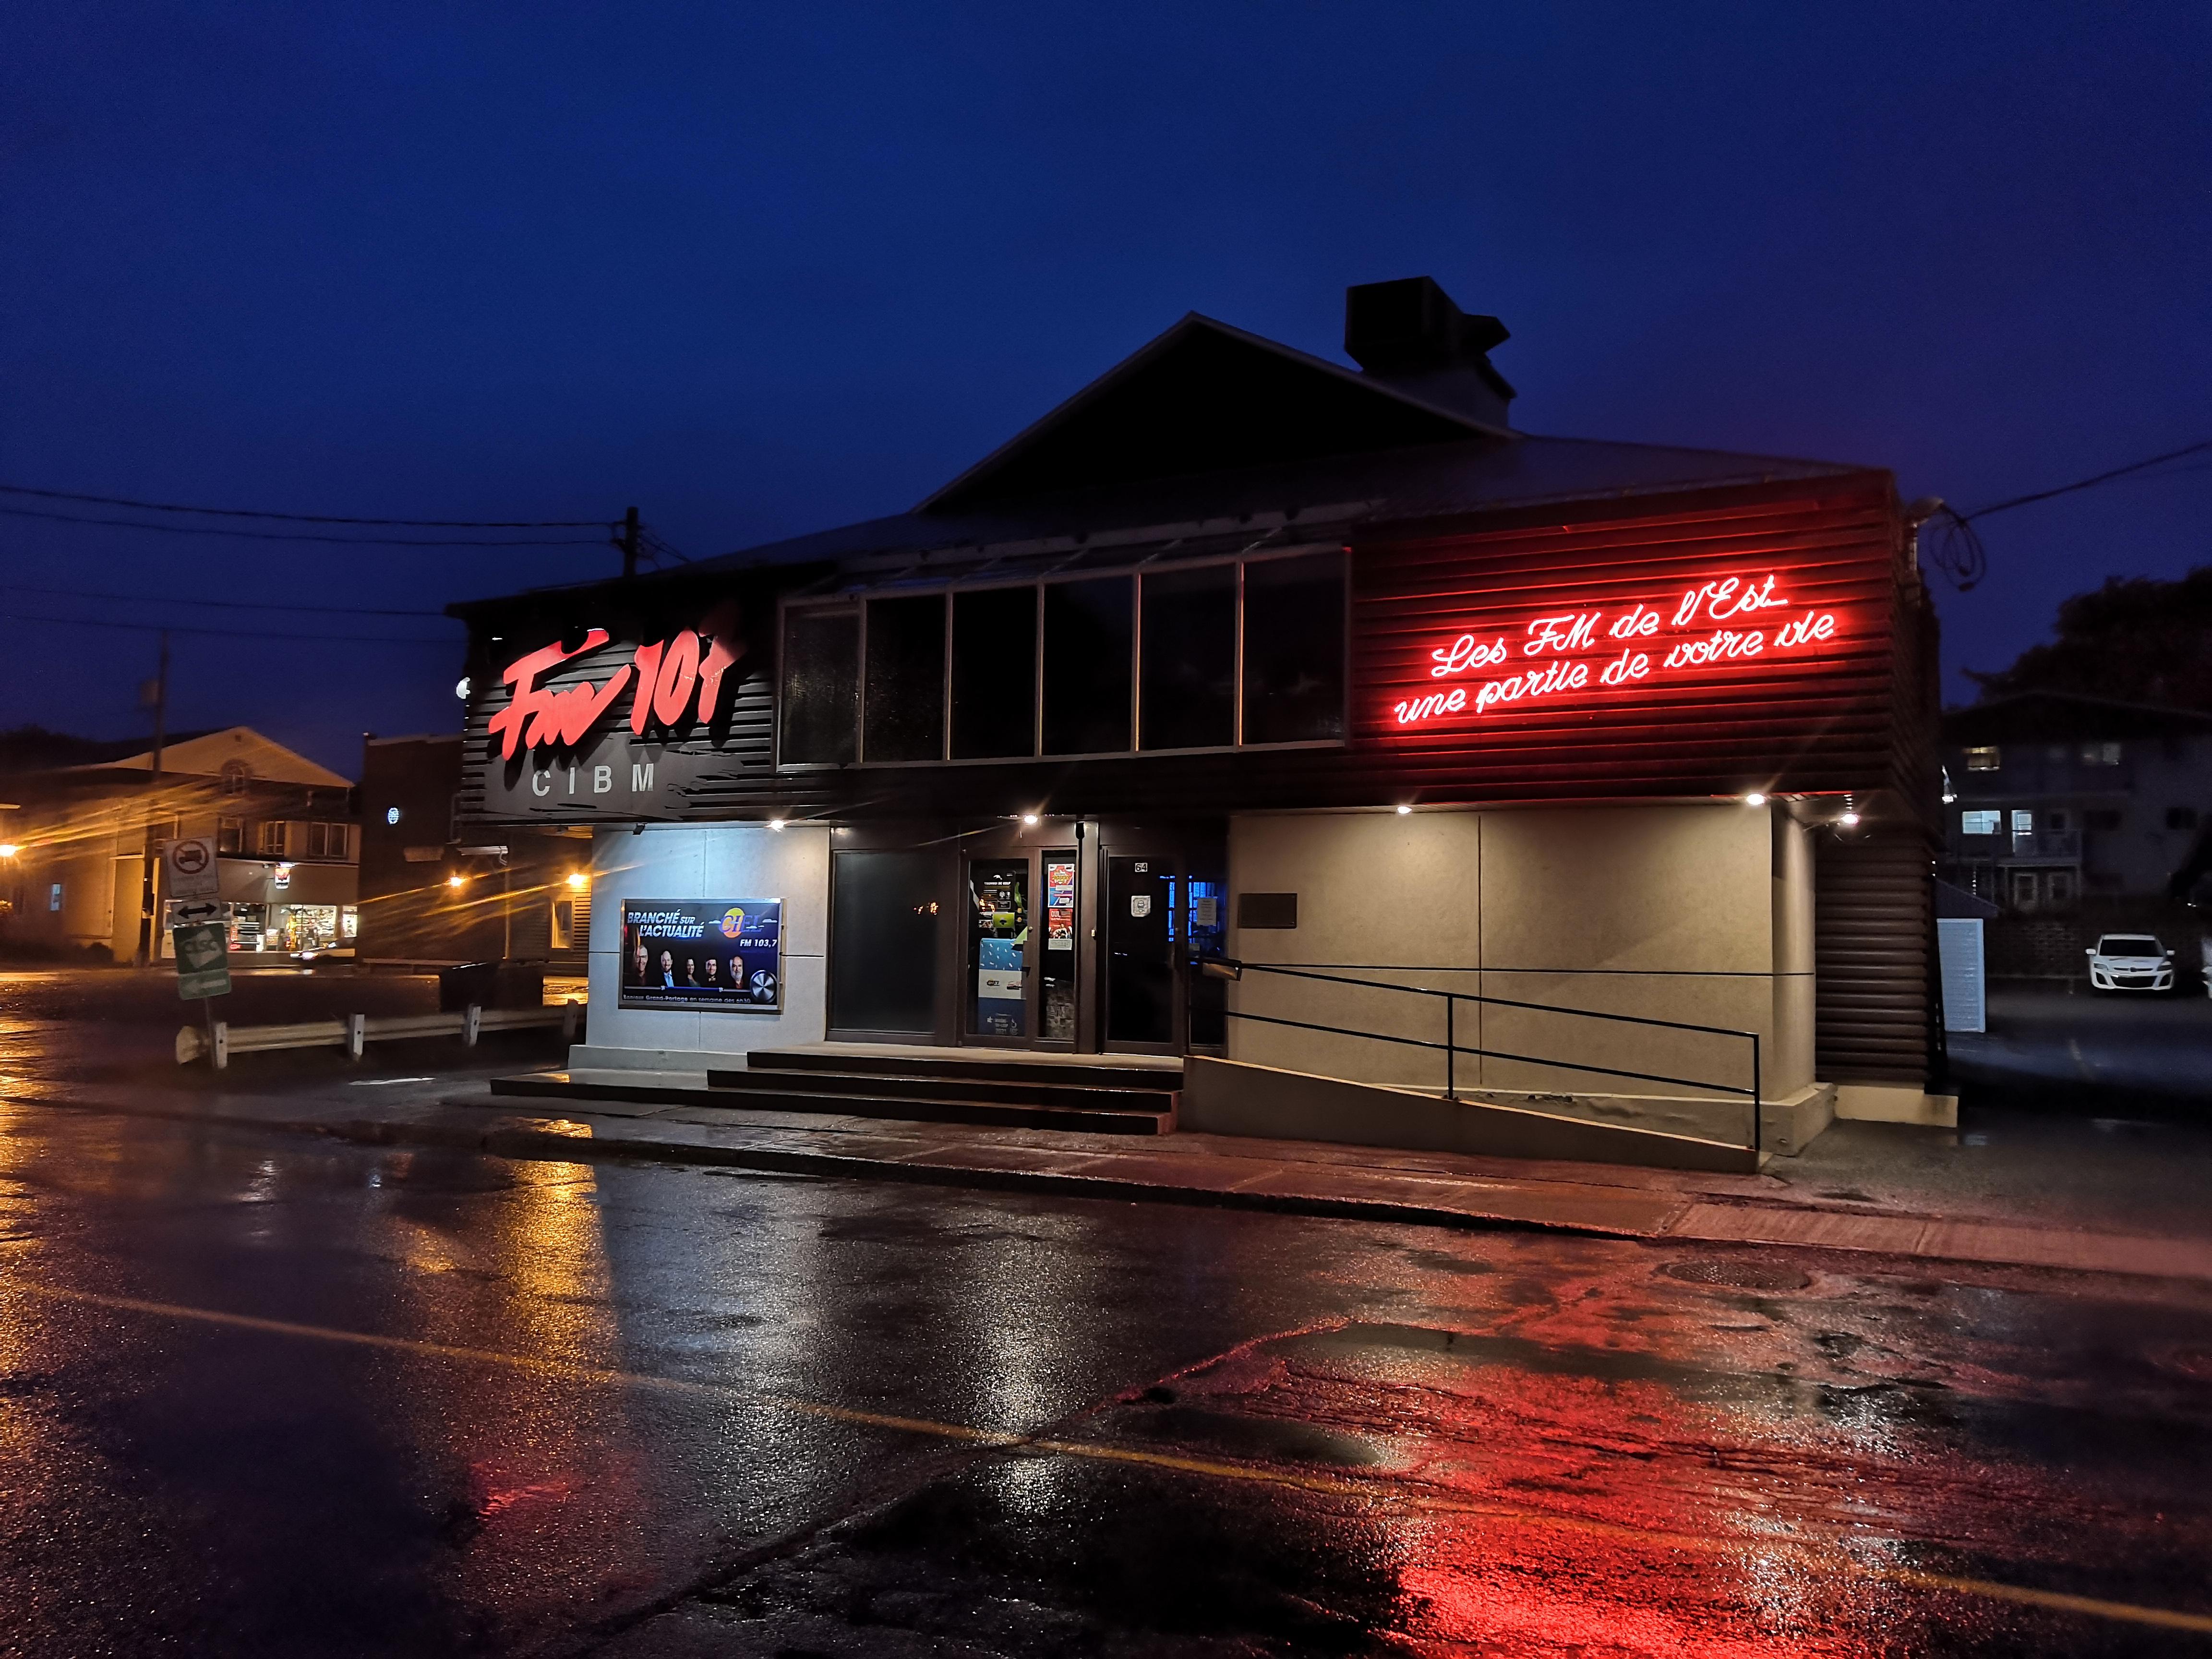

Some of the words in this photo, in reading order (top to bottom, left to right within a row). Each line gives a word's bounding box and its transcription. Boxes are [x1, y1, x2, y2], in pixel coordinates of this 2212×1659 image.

[1431, 634, 1507, 677] Les
[1523, 613, 1601, 656] FM
[1609, 603, 1660, 639] de
[1671, 575, 1789, 626] l'Est
[1394, 688, 1466, 724] une
[1475, 660, 1588, 714] partie
[1599, 648, 1650, 685] de
[1663, 629, 1765, 668] votre
[1773, 611, 1835, 647] vie
[532, 763, 654, 797] CIBM
[627, 909, 681, 924] BRANCHÉ
[680, 916, 696, 925] SUR
[639, 921, 705, 938] L'ACTUALITÉ
[740, 939, 752, 947] FM
[754, 939, 777, 949] 103,7
